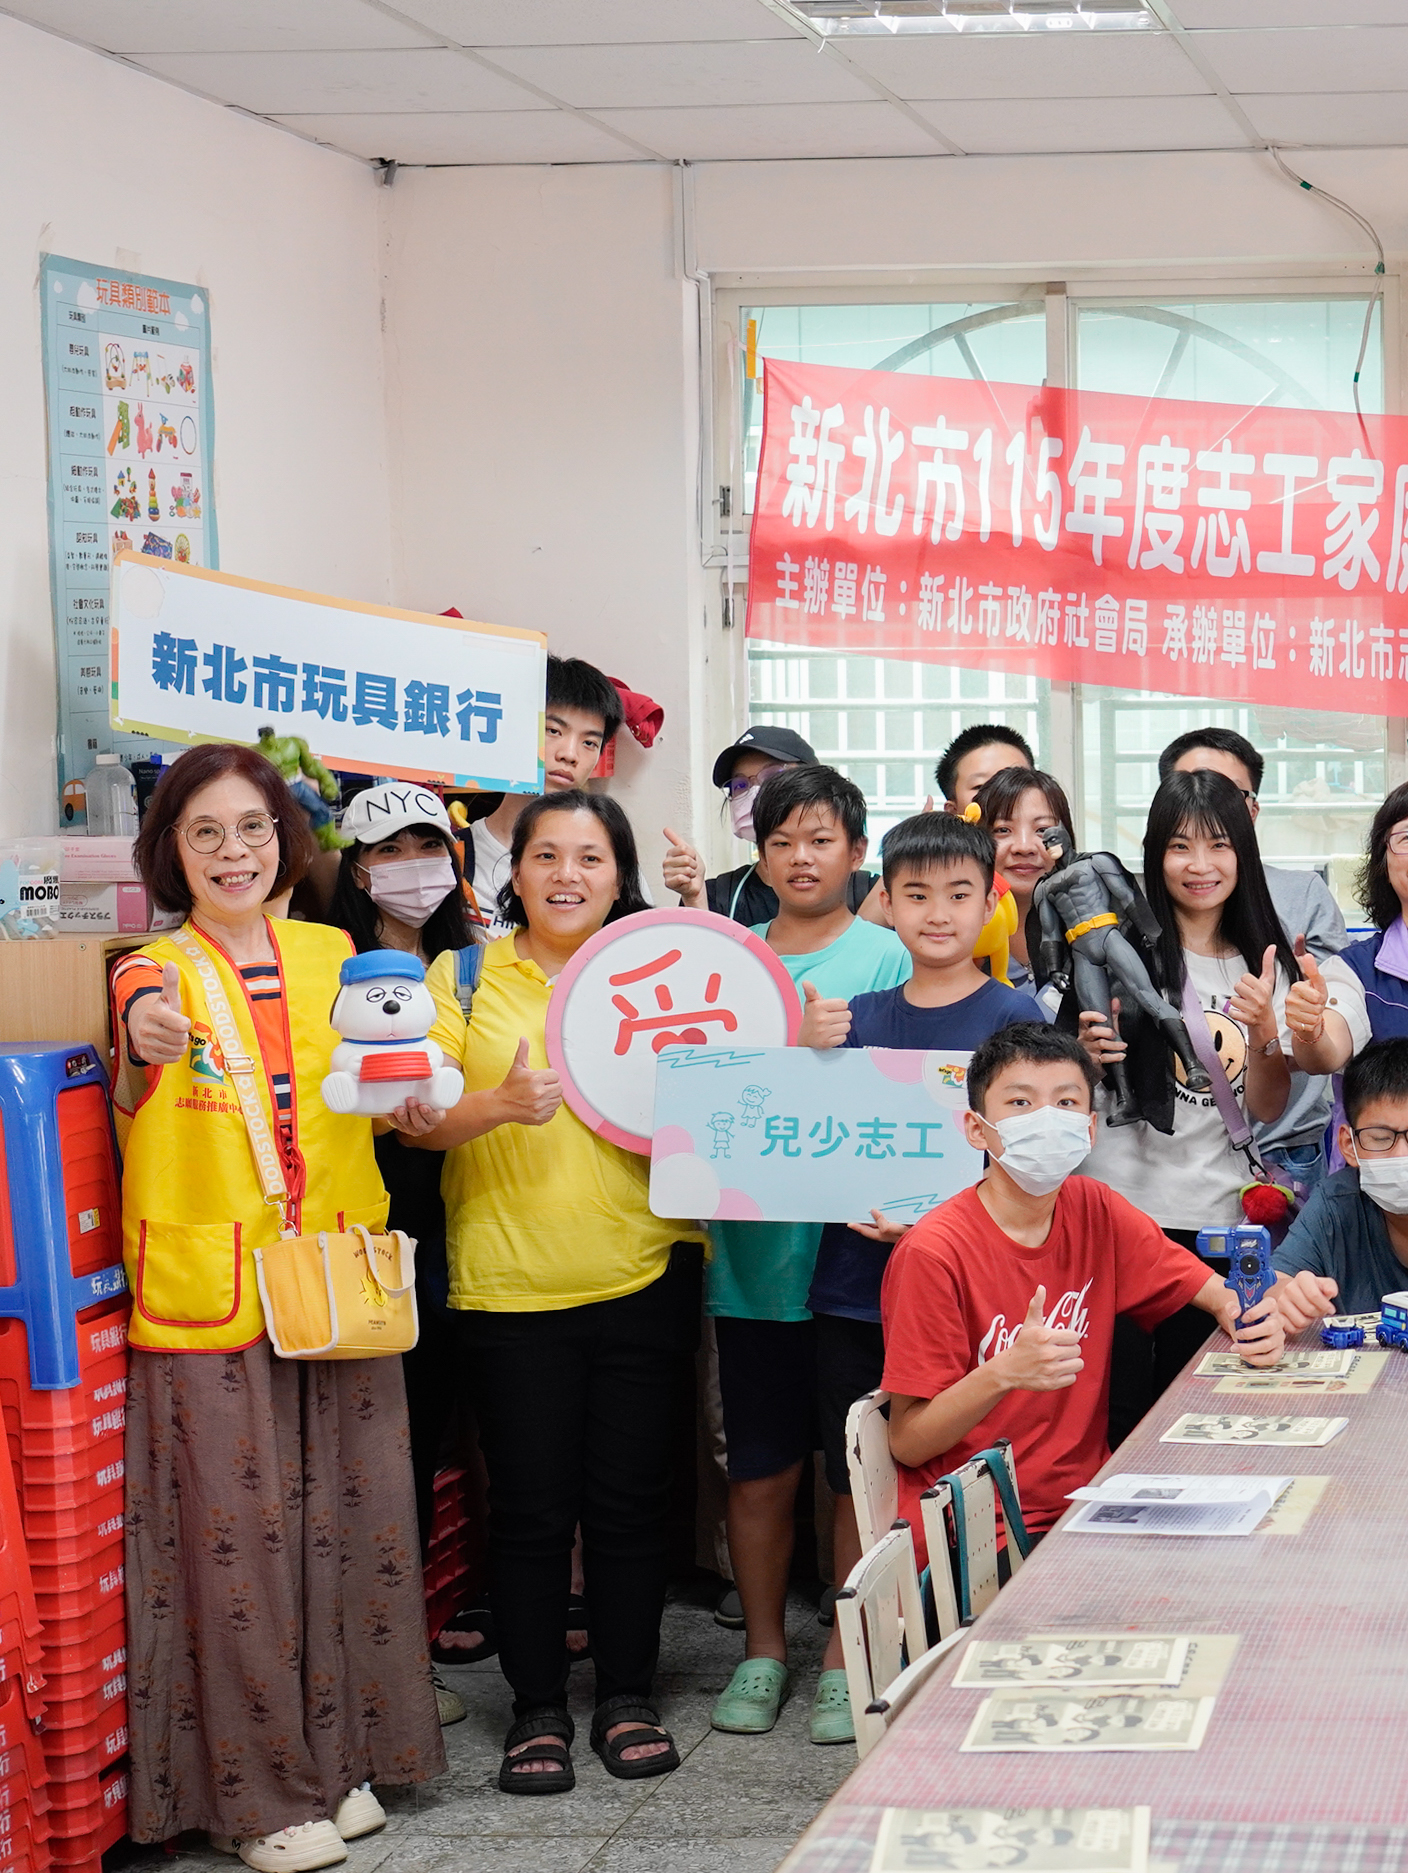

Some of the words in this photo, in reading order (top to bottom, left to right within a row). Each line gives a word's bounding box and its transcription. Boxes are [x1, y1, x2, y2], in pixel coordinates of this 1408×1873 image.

[96, 278, 171, 316] 玩具類別範本
[775, 551, 1149, 658] 主辦單位：新北市政府社會局
[151, 630, 504, 744] 新北市玩具銀行
[366, 790, 438, 822] NYC
[192, 1086, 228, 1100] 新北市
[759, 1114, 944, 1159] 兒少志工
[353, 1246, 393, 1262] WOOSTOCK
